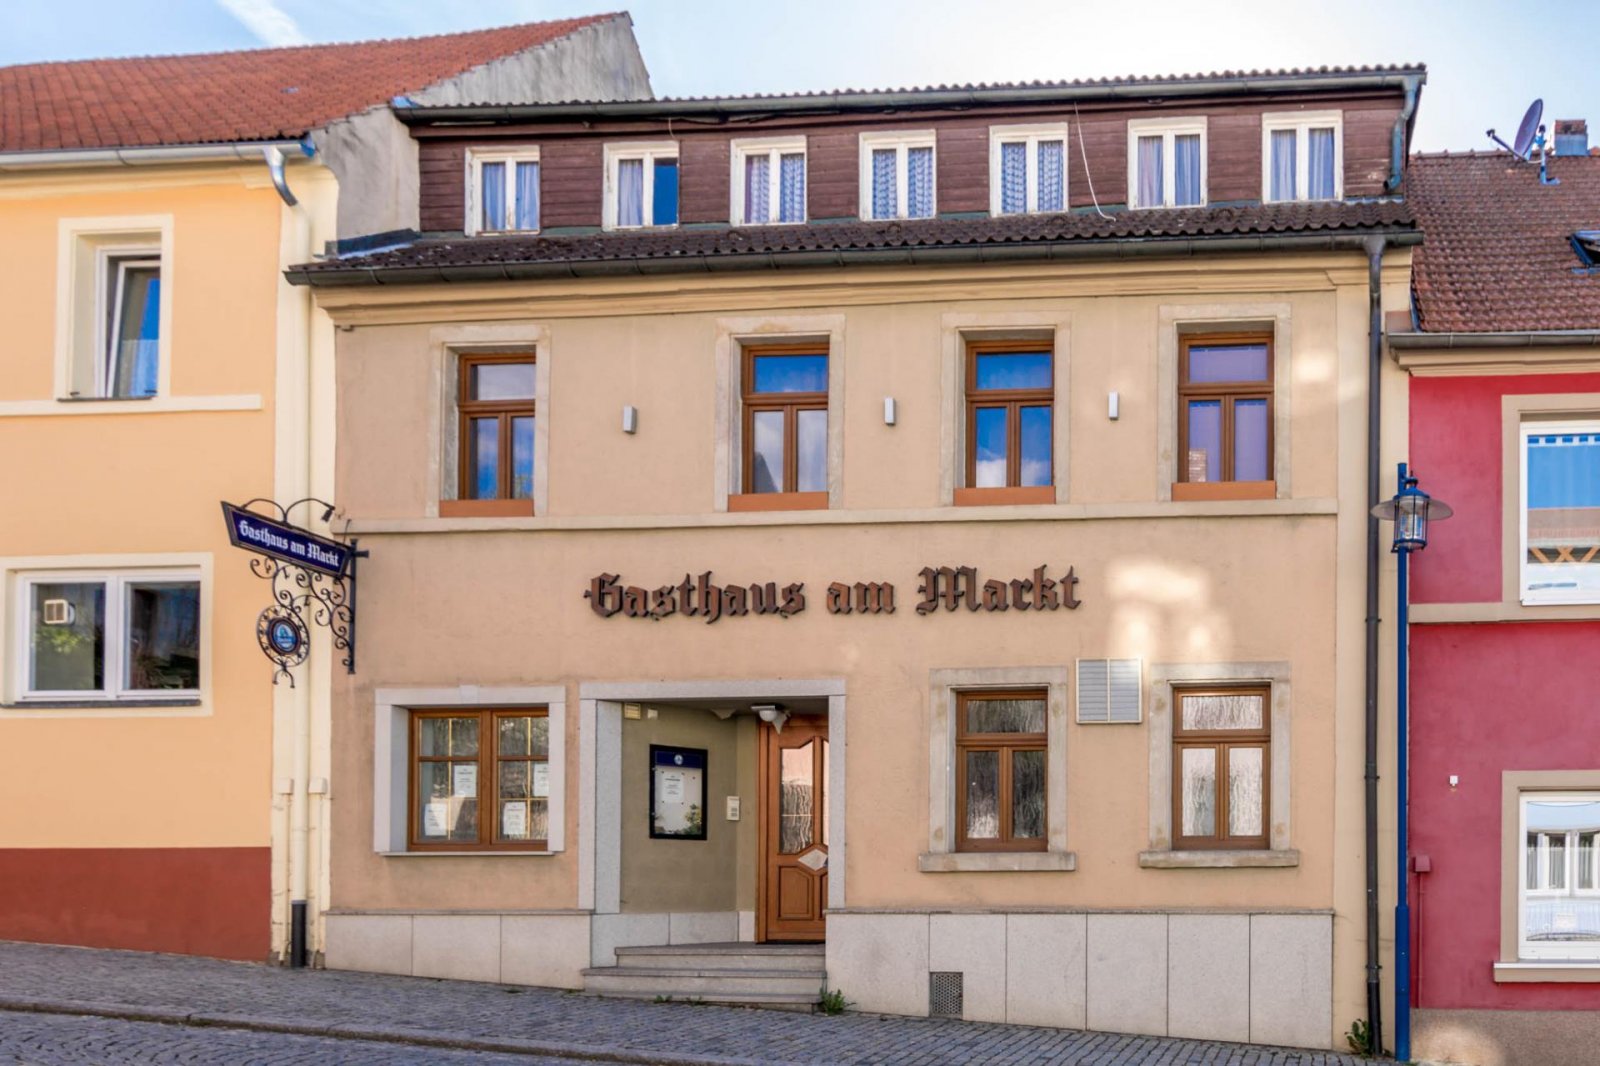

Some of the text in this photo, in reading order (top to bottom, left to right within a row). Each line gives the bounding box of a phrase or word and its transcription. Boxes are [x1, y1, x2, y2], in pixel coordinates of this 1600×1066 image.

[239, 520, 340, 567] Gasthaus am Markt
[584, 563, 1082, 625] Gasthaus am Markt
